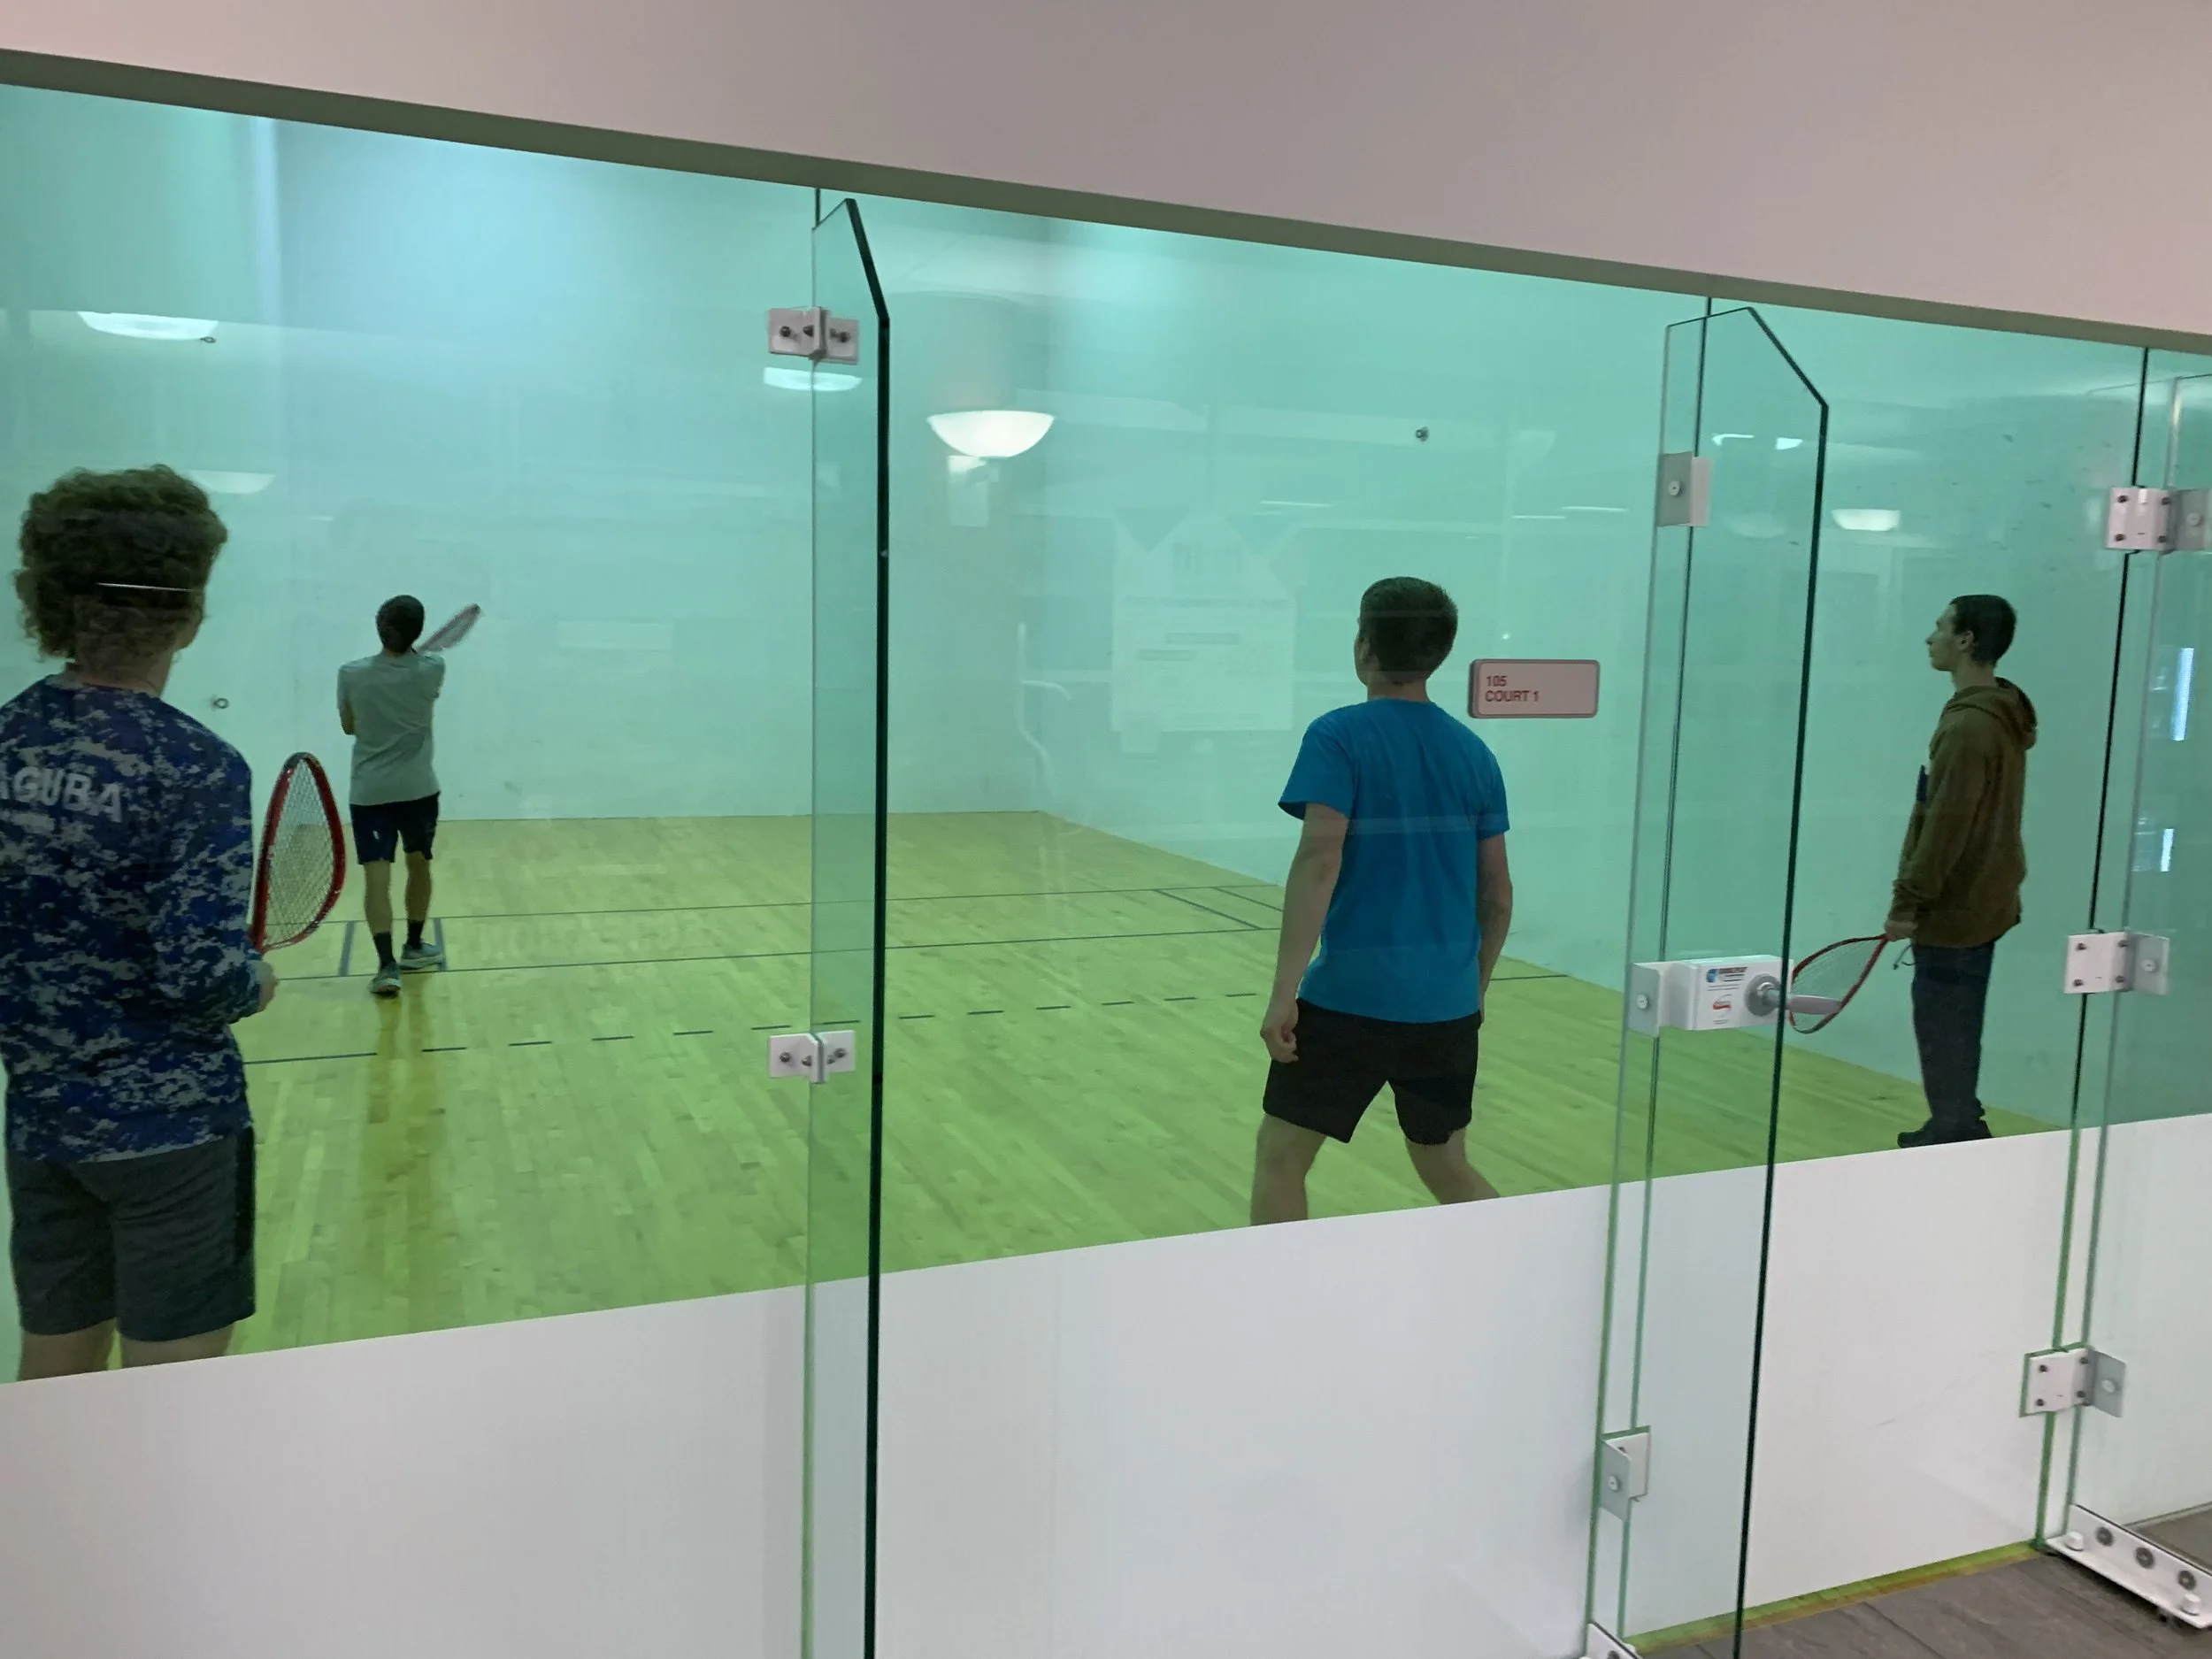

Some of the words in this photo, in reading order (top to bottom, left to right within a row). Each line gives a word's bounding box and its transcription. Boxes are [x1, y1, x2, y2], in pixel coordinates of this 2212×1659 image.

[1486, 675, 1508, 687] 105
[1485, 690, 1531, 702] COURT
[1532, 691, 1540, 702] 1
